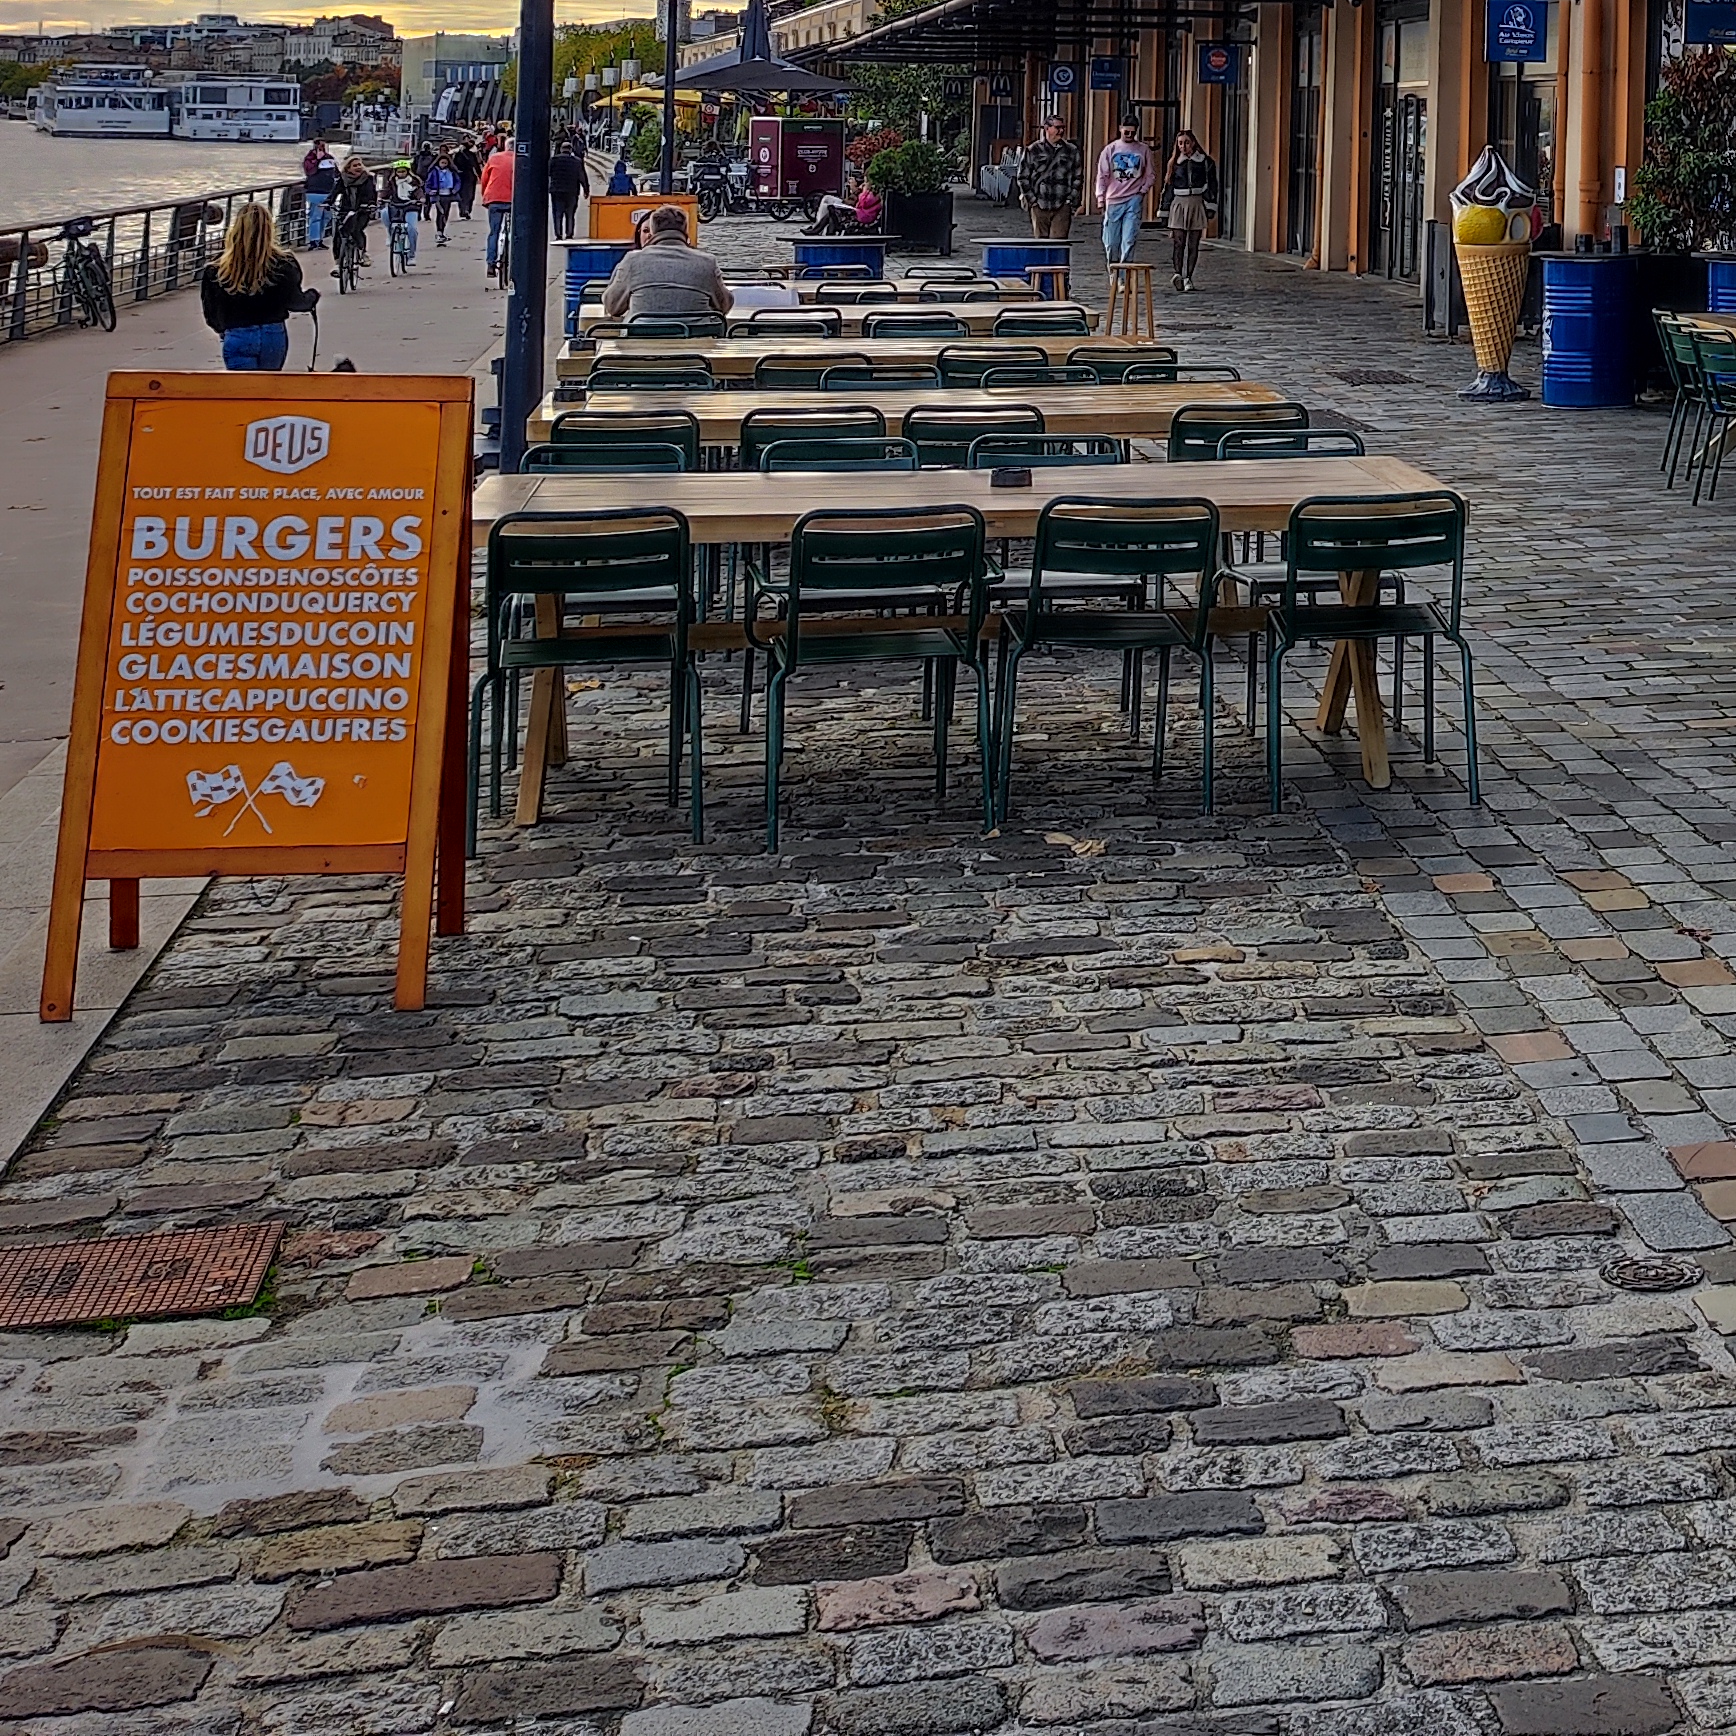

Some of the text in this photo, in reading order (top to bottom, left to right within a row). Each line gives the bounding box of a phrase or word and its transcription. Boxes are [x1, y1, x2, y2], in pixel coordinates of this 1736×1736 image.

[253, 423, 322, 464] DEUS
[133, 487, 424, 501] TOUT EST FAIT SUR PLACE, AVEC AMOUR
[131, 515, 423, 561] BURGERS
[127, 563, 419, 587] POISSONSDENOSCÔTES
[126, 591, 417, 614] COCHONDUQUERCY
[121, 616, 415, 647] LÉGUMESDUCOIN
[118, 652, 412, 681] GLACESMAISON
[110, 717, 407, 745] COOKIESGAUFRES
